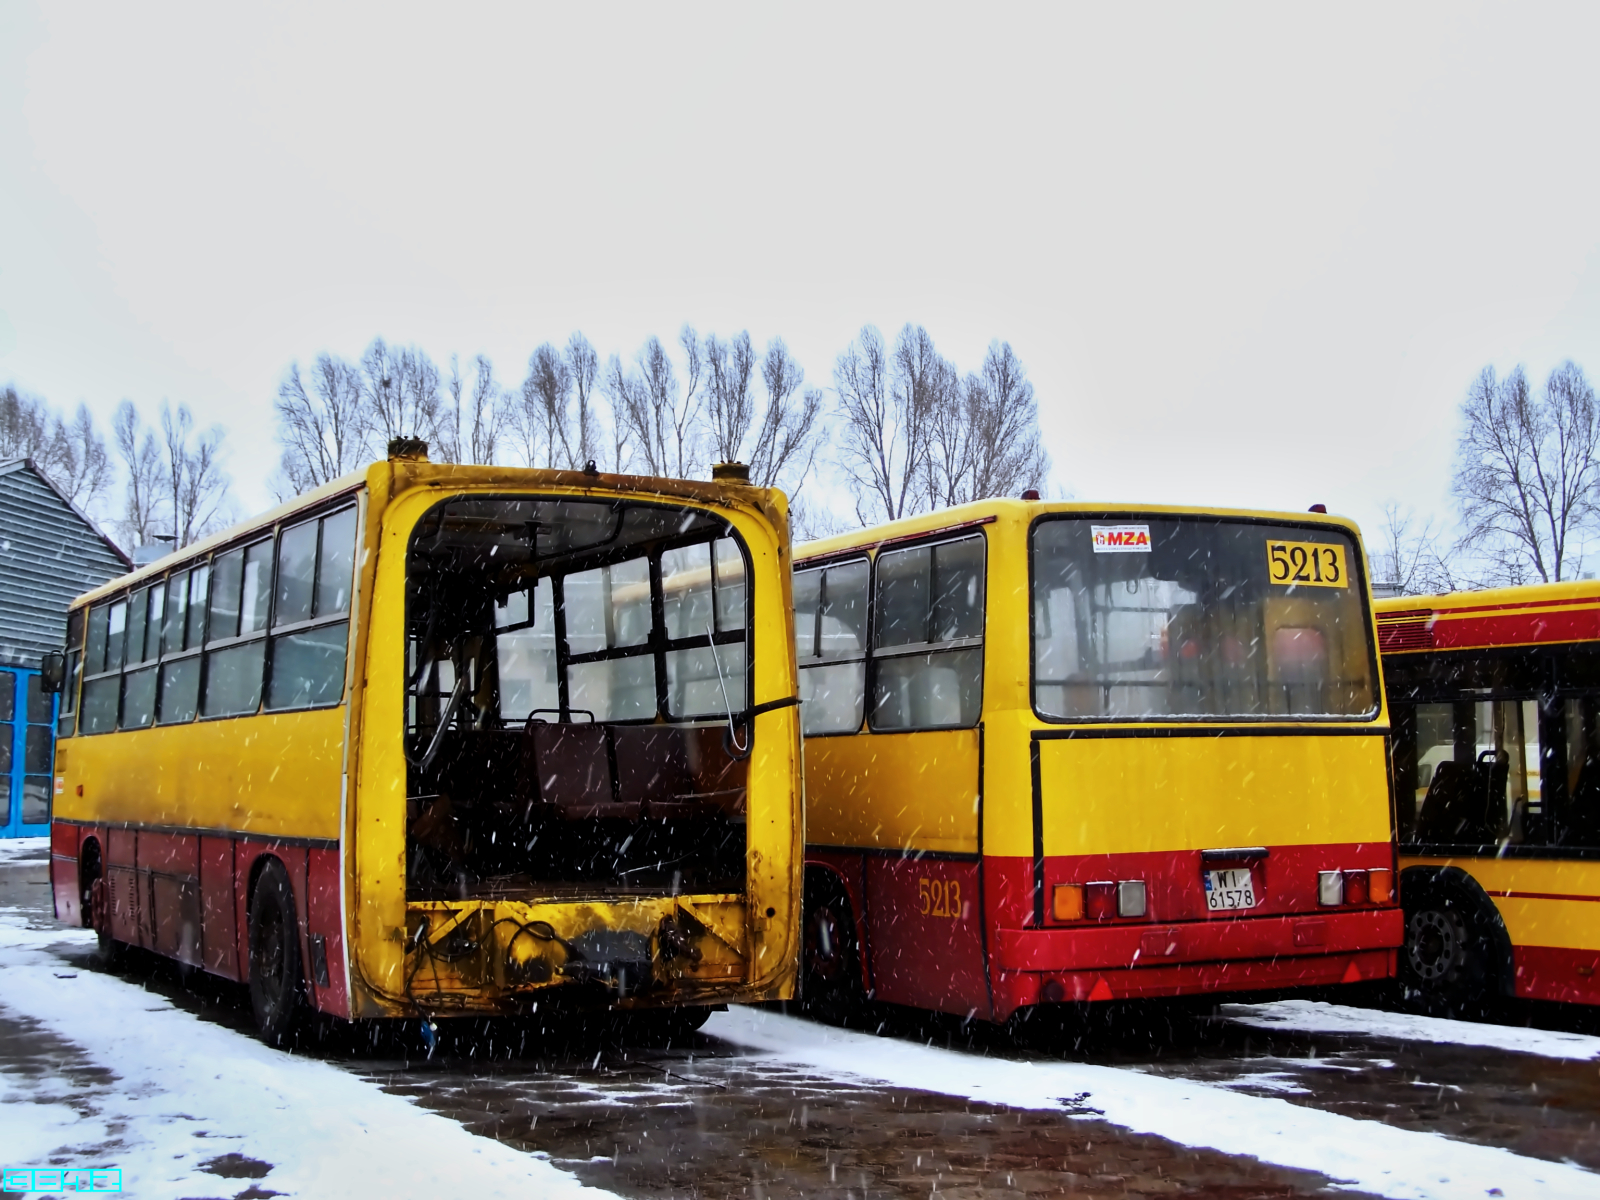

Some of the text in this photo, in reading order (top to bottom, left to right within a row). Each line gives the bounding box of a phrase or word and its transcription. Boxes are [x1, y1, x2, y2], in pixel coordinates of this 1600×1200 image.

[1107, 531, 1148, 546] MZA
[1271, 545, 1340, 583] 5213
[1216, 870, 1237, 889] WI
[919, 877, 962, 918] 5213
[1209, 889, 1253, 909] 61578
